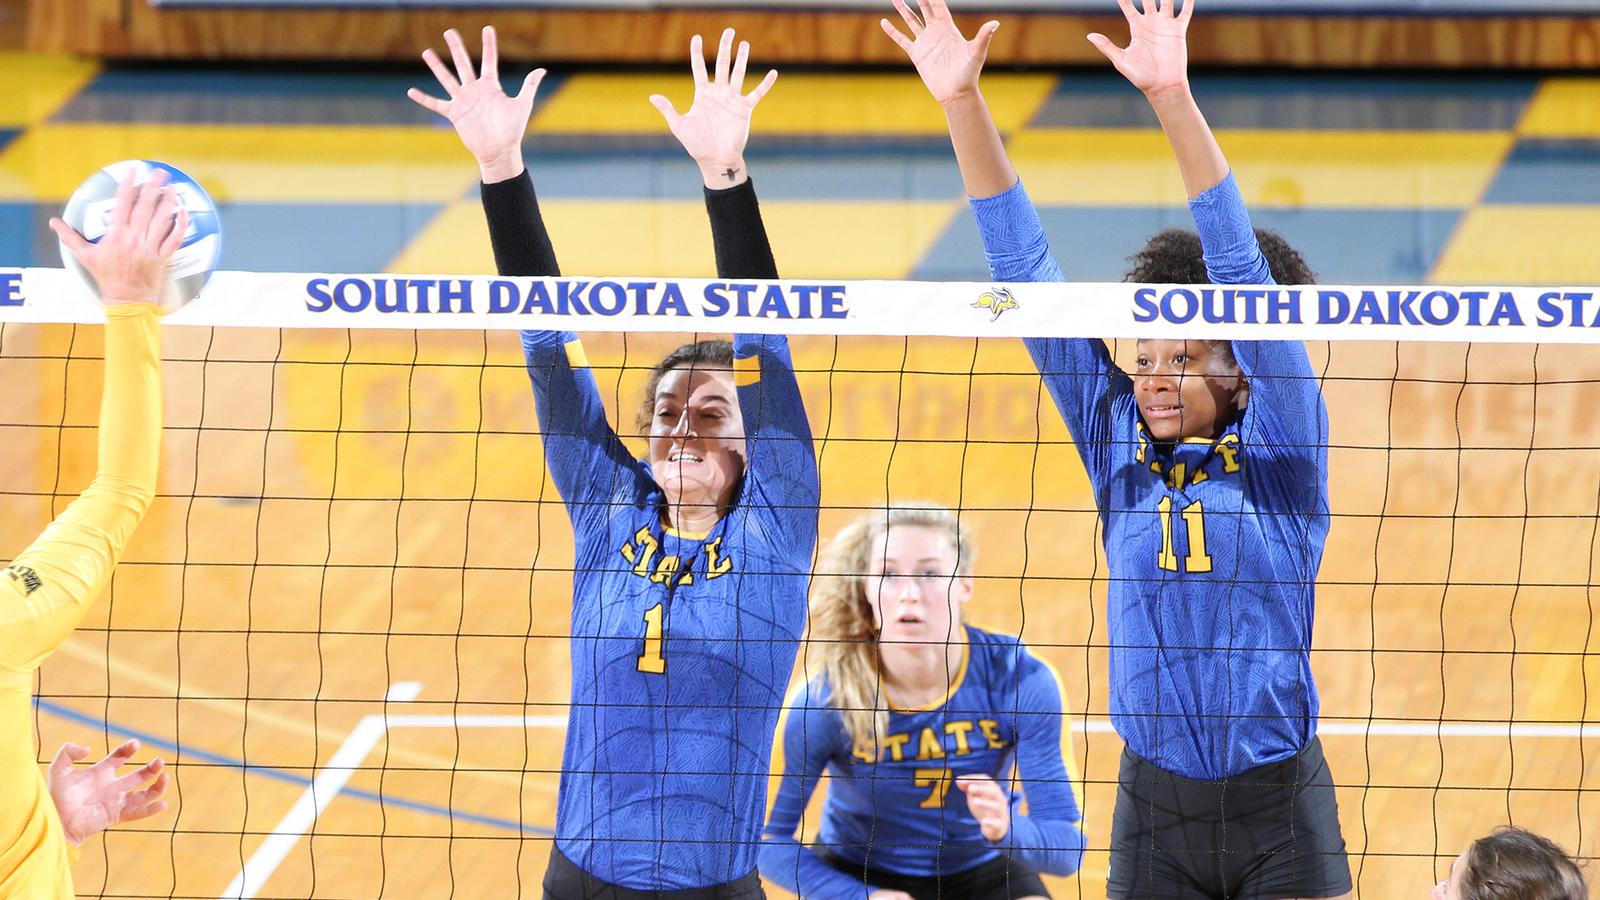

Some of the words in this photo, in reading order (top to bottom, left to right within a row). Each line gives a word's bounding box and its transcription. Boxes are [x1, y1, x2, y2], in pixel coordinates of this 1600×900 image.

[305, 278, 475, 314] SOUTH
[486, 281, 693, 317] DAKOTA
[702, 283, 850, 319] STATE
[1133, 288, 1302, 325] SOUTH
[1316, 290, 1526, 326] DAKOTA
[620, 523, 733, 589] TAE
[1157, 494, 1213, 573] 11
[637, 602, 666, 674] 1
[914, 767, 953, 809] 7
